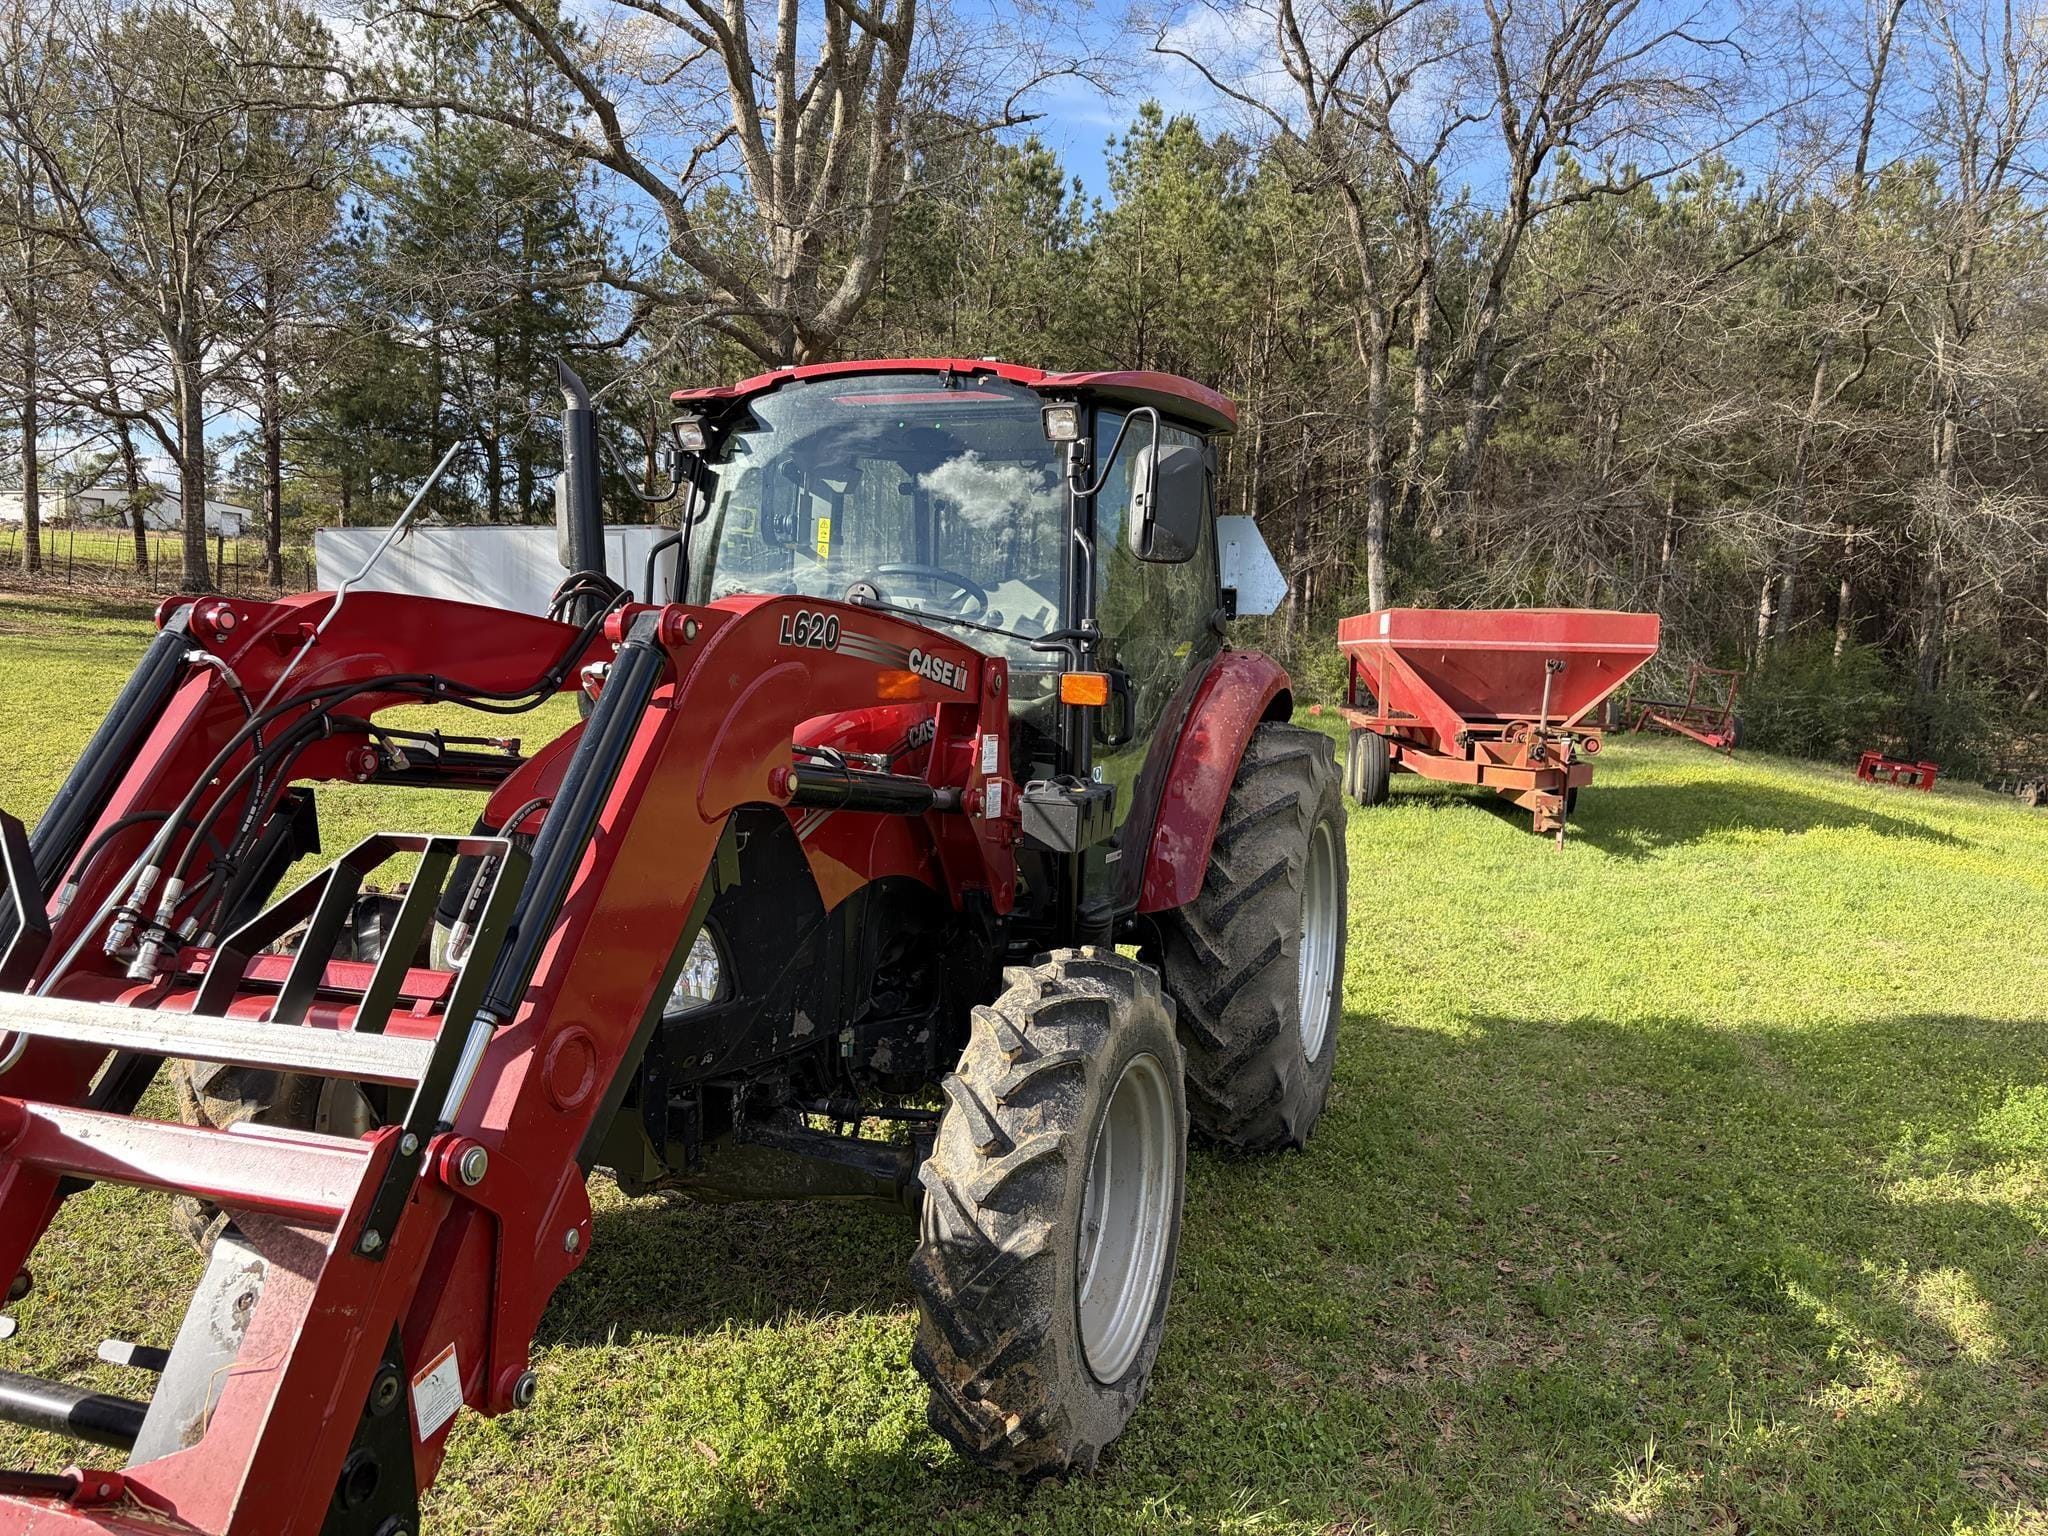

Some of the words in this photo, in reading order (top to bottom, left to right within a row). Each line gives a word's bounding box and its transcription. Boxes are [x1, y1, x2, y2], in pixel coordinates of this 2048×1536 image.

[779, 610, 840, 650] L620
[909, 648, 954, 686] CASE
[909, 718, 936, 749] CAS
